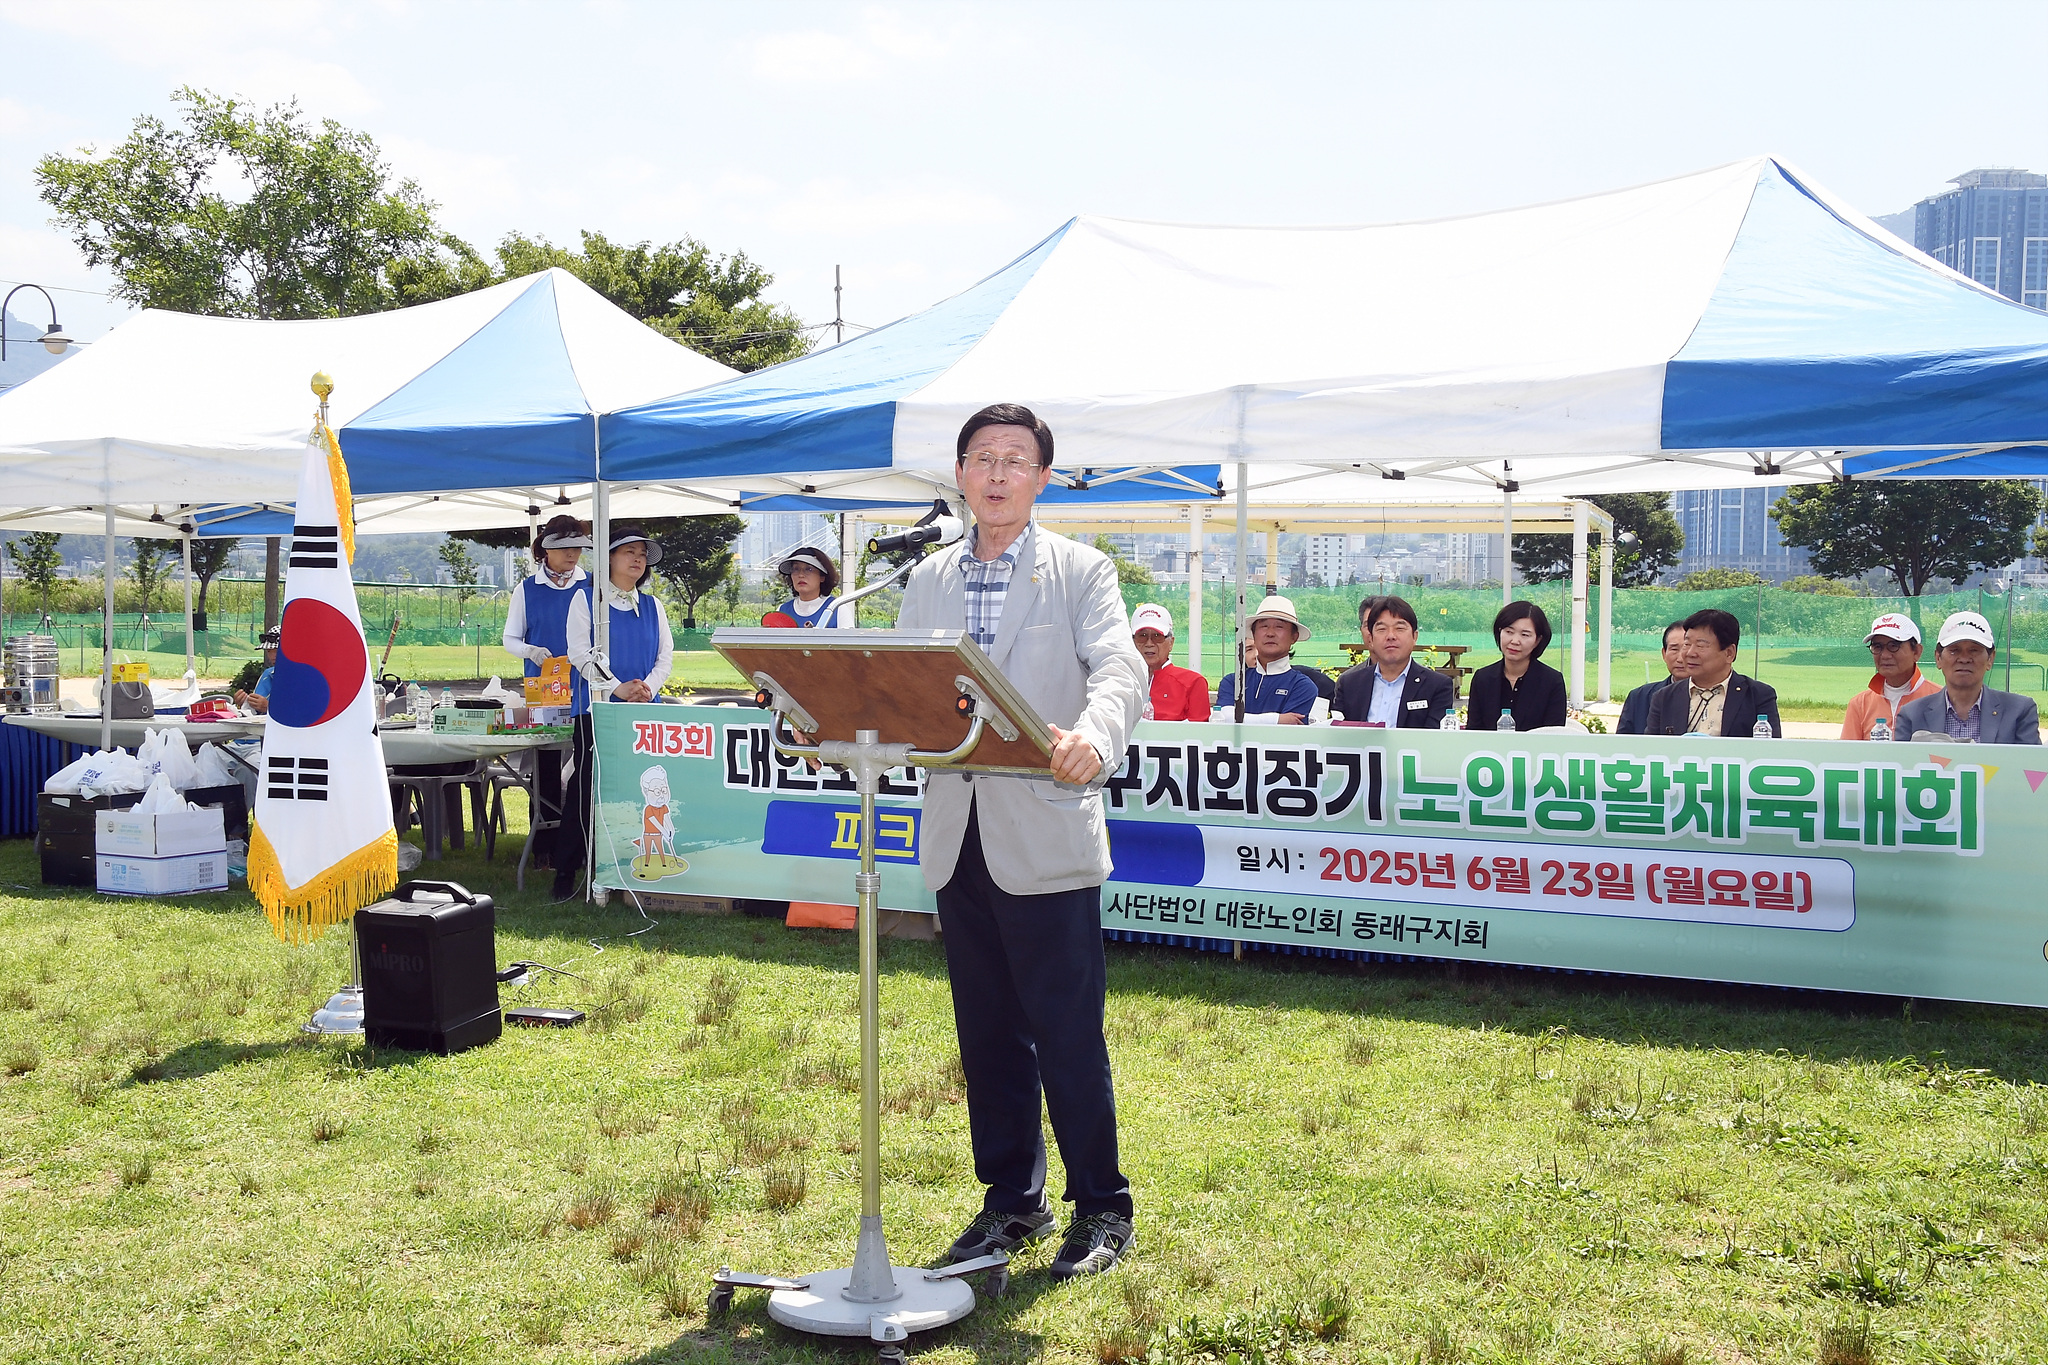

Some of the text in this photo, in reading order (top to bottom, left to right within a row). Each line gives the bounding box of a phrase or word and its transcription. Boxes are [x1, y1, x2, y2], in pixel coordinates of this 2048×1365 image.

[632, 721, 713, 757] 제3회
[1400, 754, 1977, 851] 노인생활체육대회
[1319, 846, 1457, 891] 2025년
[1466, 855, 1531, 896] 6월
[1541, 859, 1635, 902] 23일
[1645, 863, 1813, 914] (월요일)
[1107, 891, 1489, 949] 사단법인 대한노인회 동래구지회
